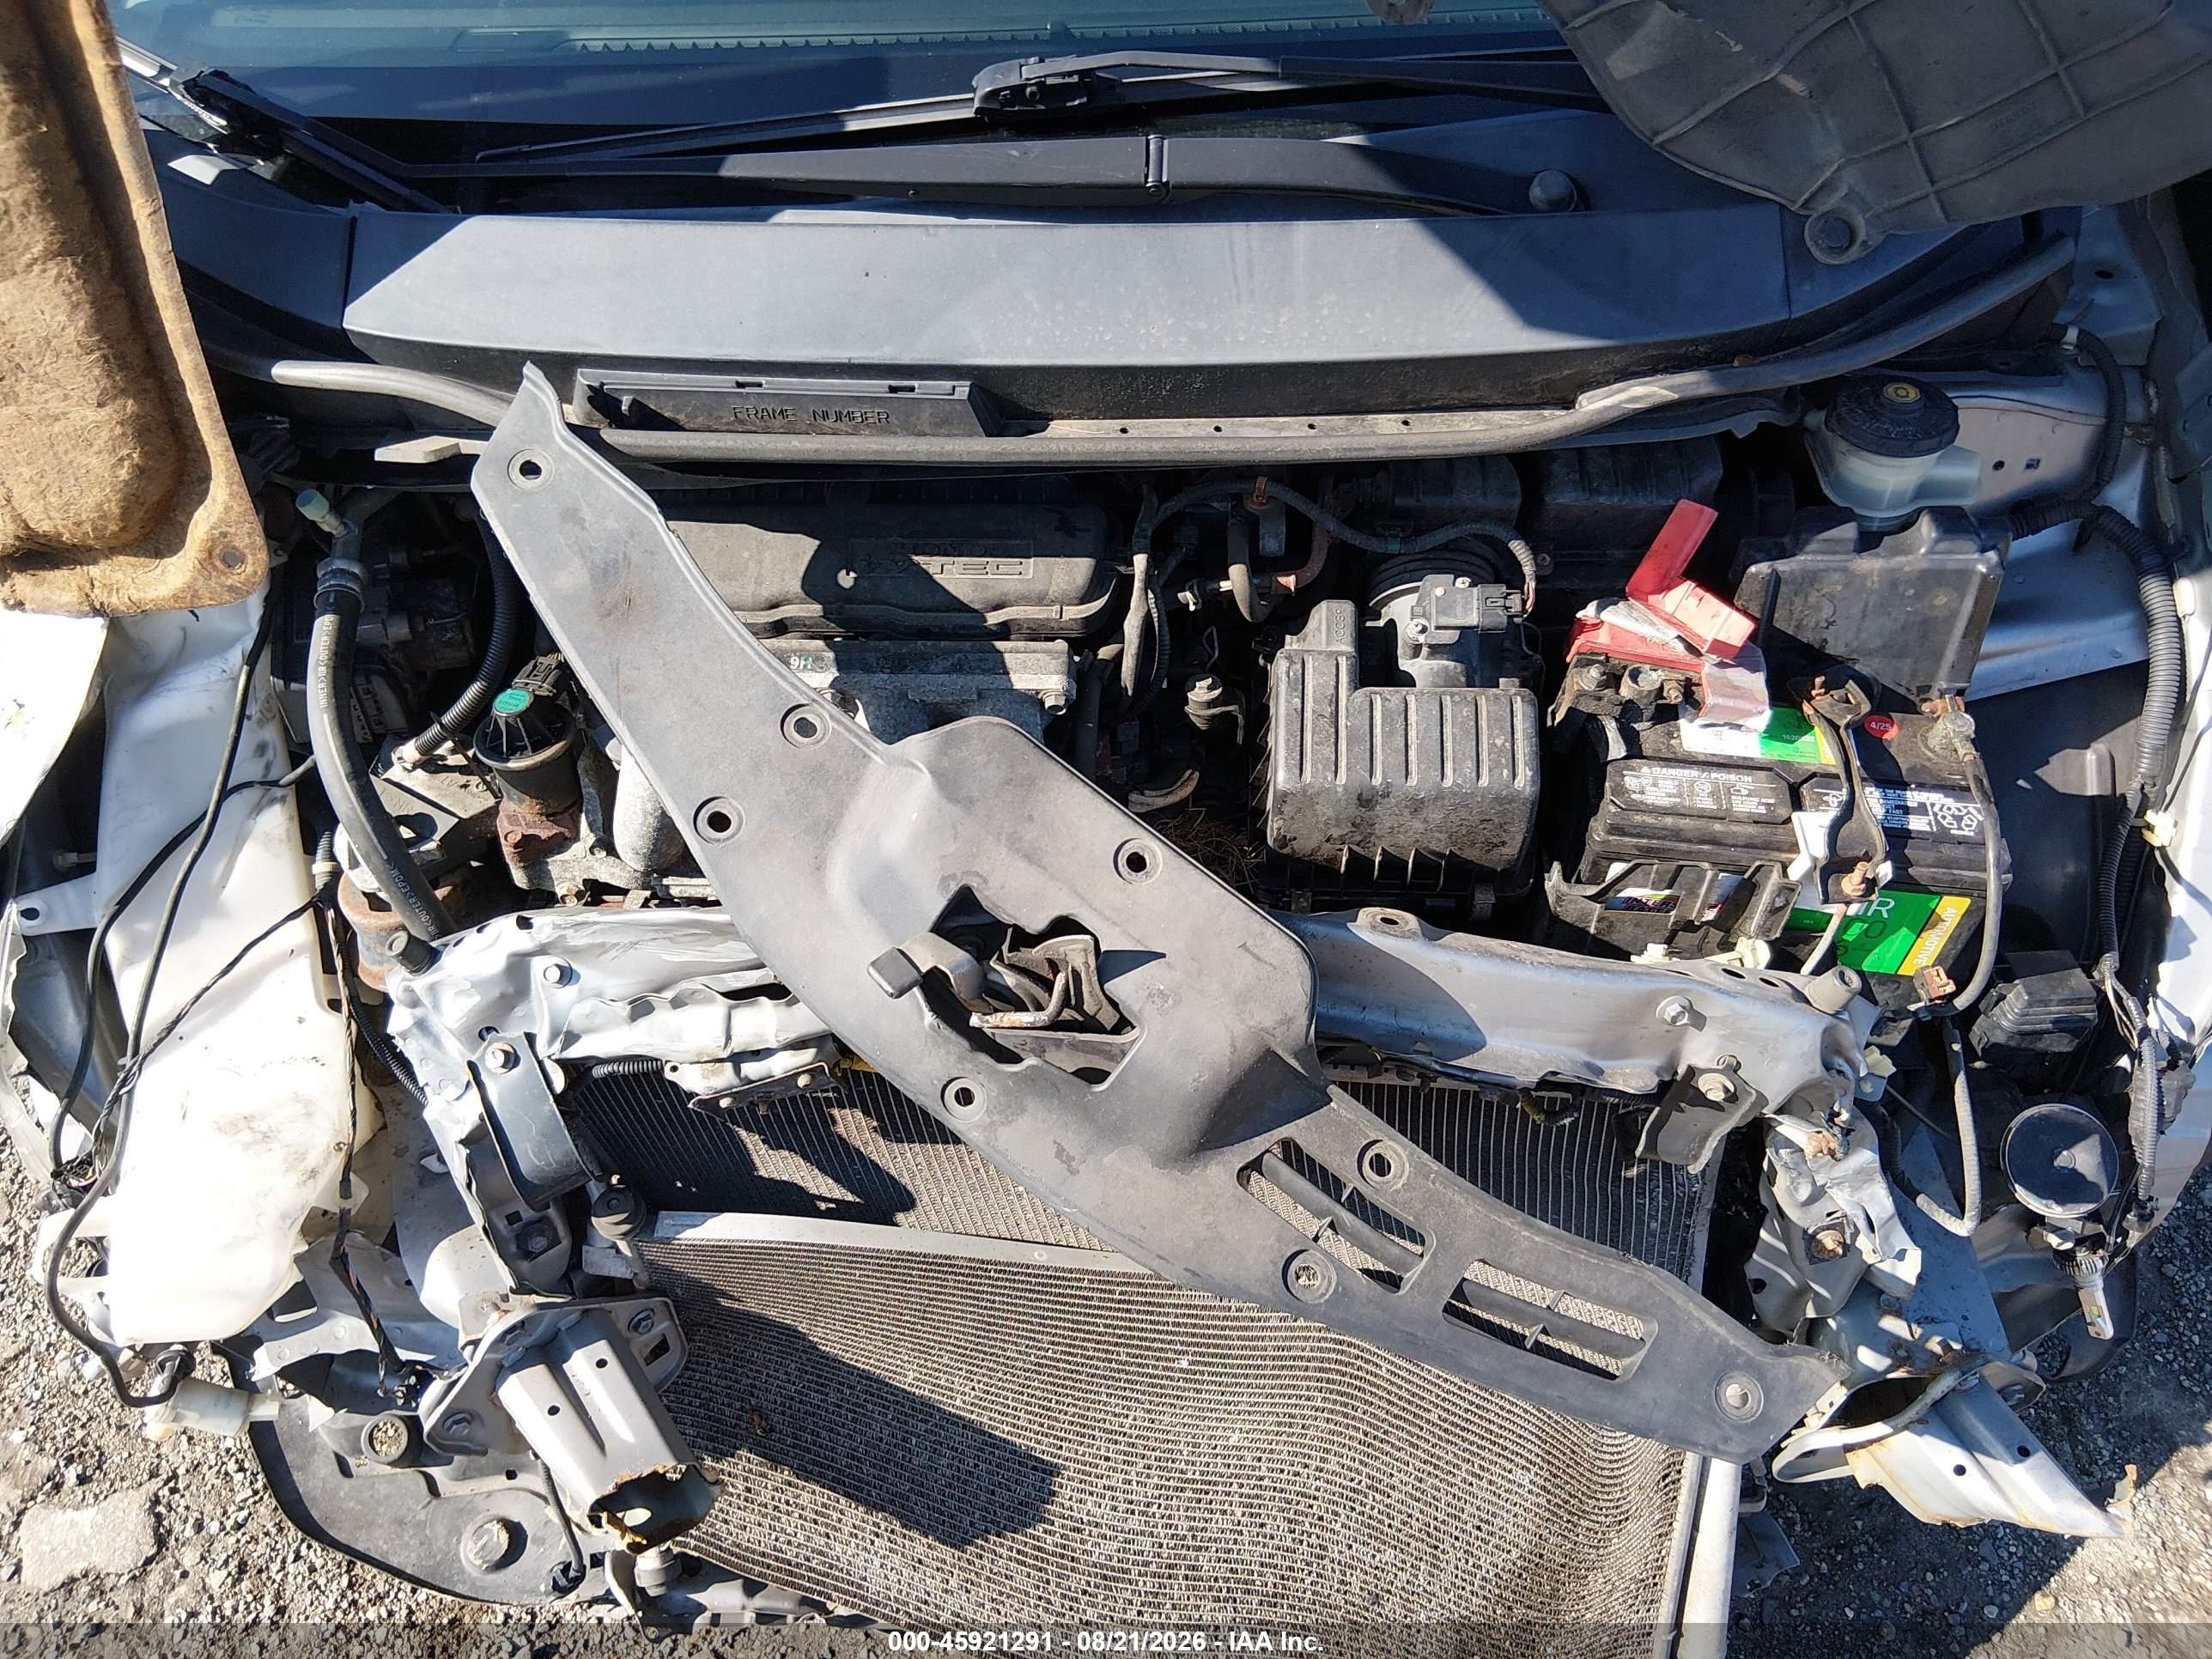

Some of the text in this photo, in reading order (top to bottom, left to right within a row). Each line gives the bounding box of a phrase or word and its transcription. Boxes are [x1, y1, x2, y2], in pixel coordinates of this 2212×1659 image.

[732, 405, 890, 424] FRAME NUMBER
[1652, 767, 1699, 778] DANGER
[1711, 772, 1753, 783] POISON
[1914, 907, 1959, 966] AUTOMOTIVE
